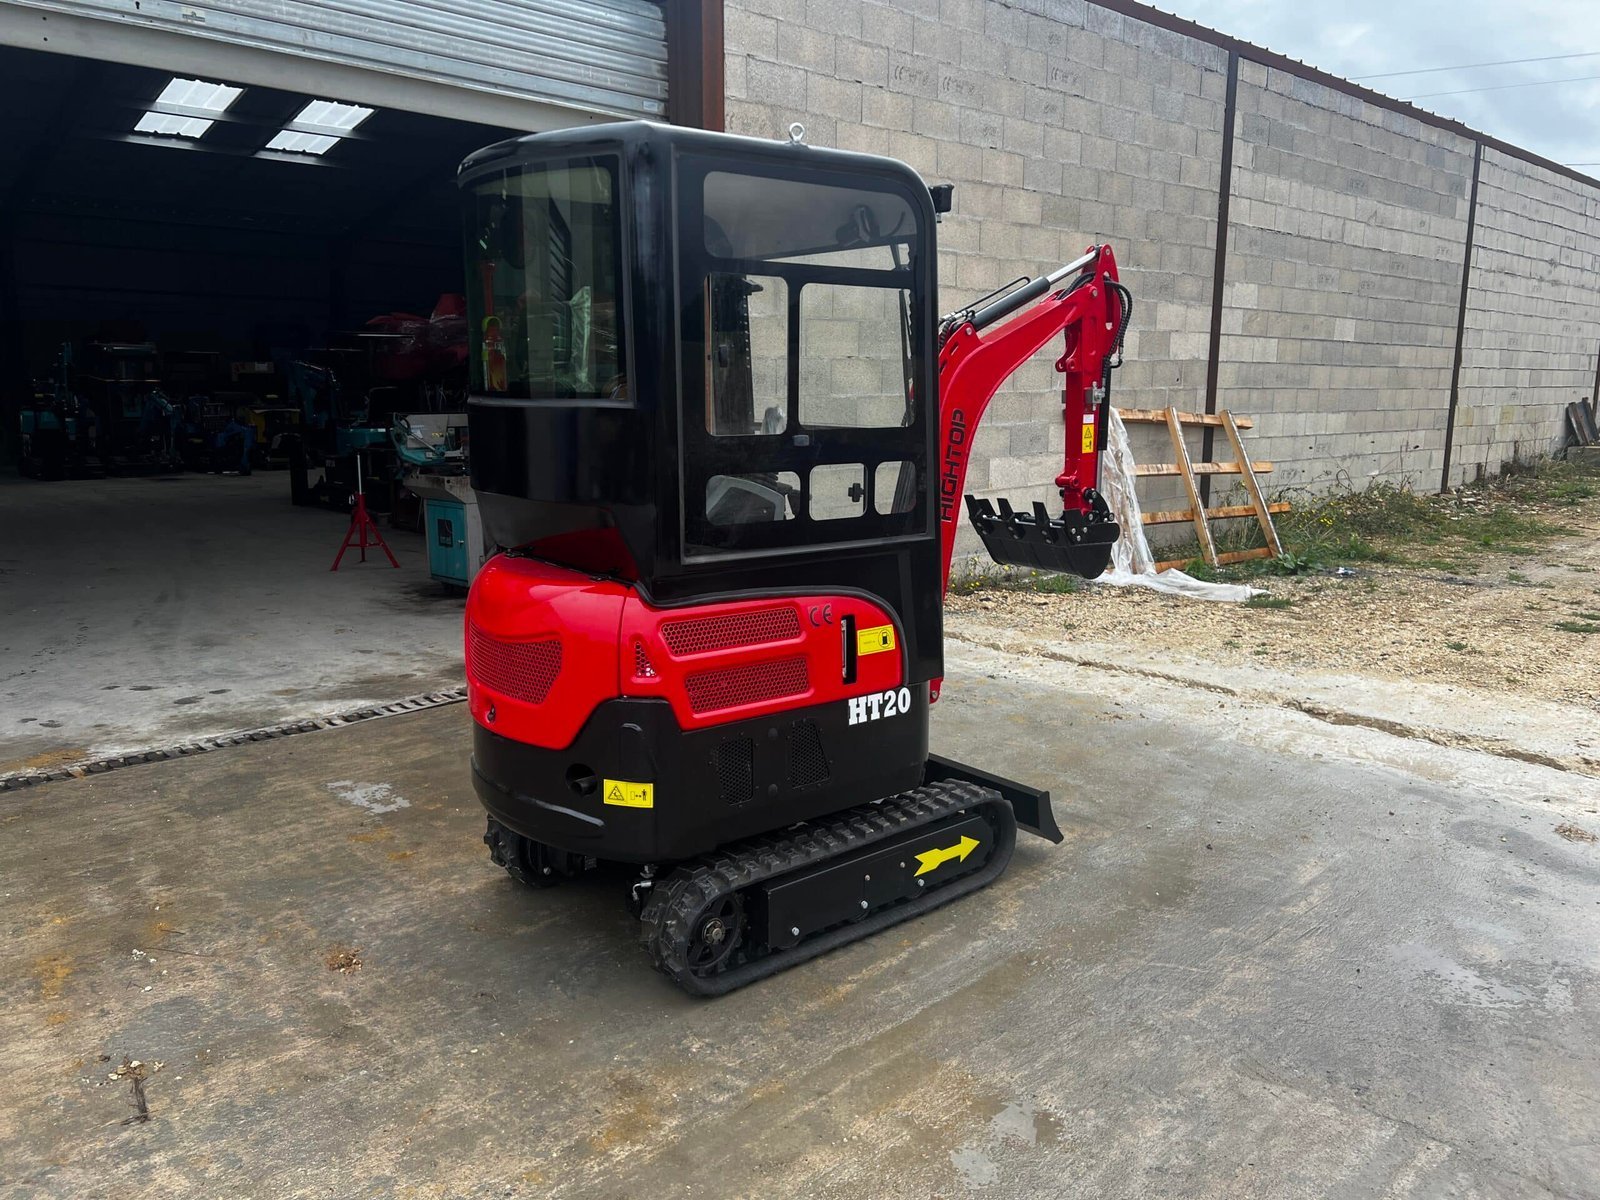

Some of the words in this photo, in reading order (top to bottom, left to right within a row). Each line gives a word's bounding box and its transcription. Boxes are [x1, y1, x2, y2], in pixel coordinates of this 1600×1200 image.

[941, 408, 966, 522] HIGHTOP
[810, 604, 832, 627] CE
[848, 687, 911, 726] HT20
